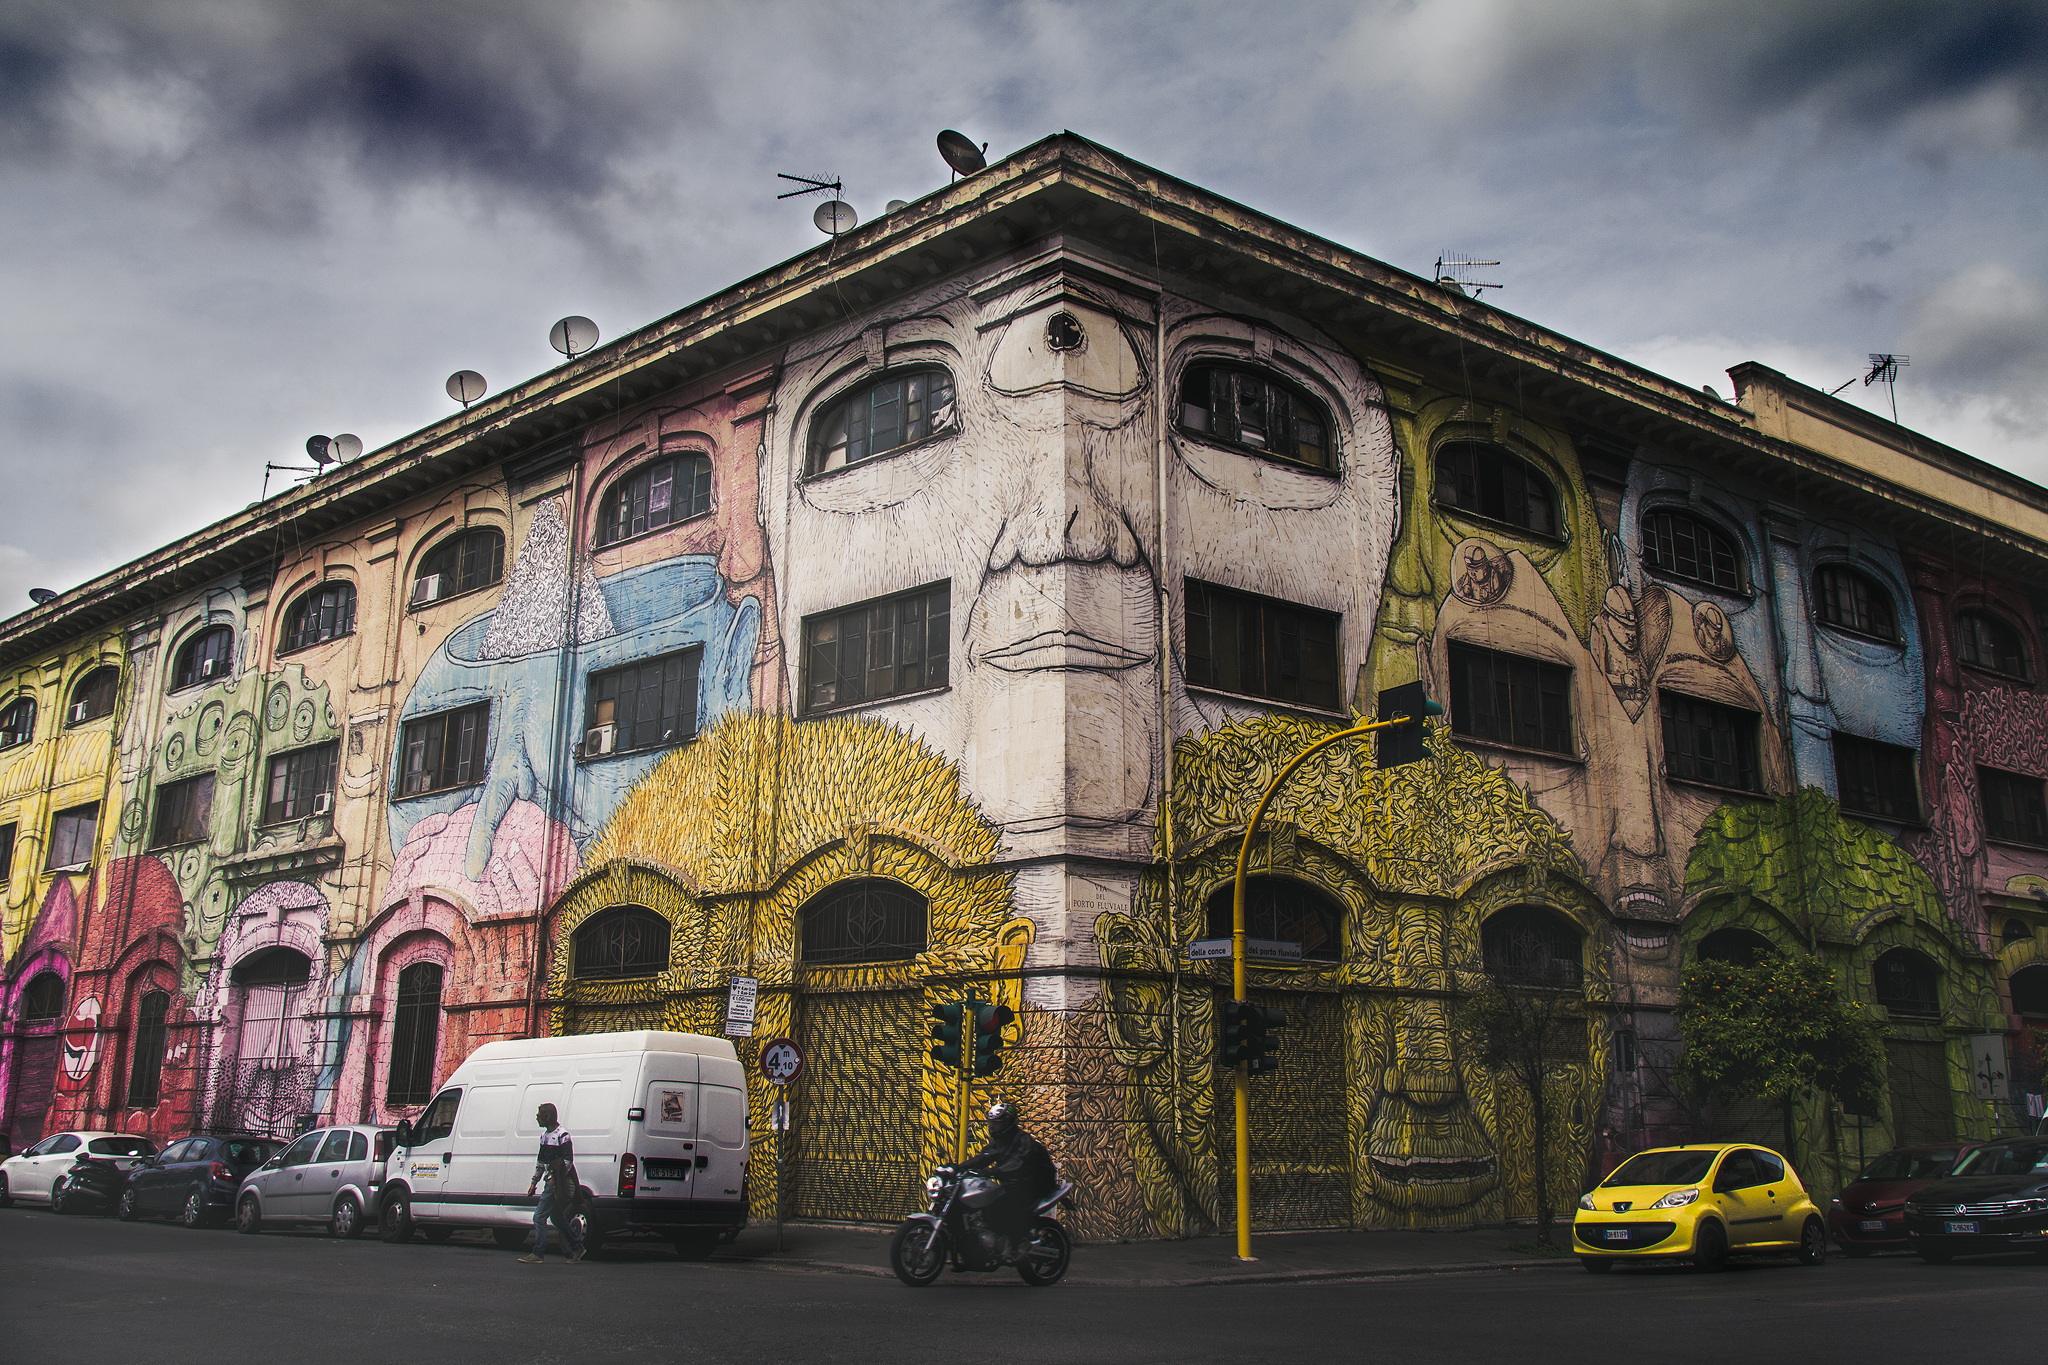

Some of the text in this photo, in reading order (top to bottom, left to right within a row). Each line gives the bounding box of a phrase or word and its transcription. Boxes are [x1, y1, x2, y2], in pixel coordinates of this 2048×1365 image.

[1094, 884, 1107, 892] VIA
[1073, 900, 1128, 911] PORTO FLUVIALE
[1191, 949, 1206, 957] delle
[1248, 946, 1300, 958] del porto fluviale
